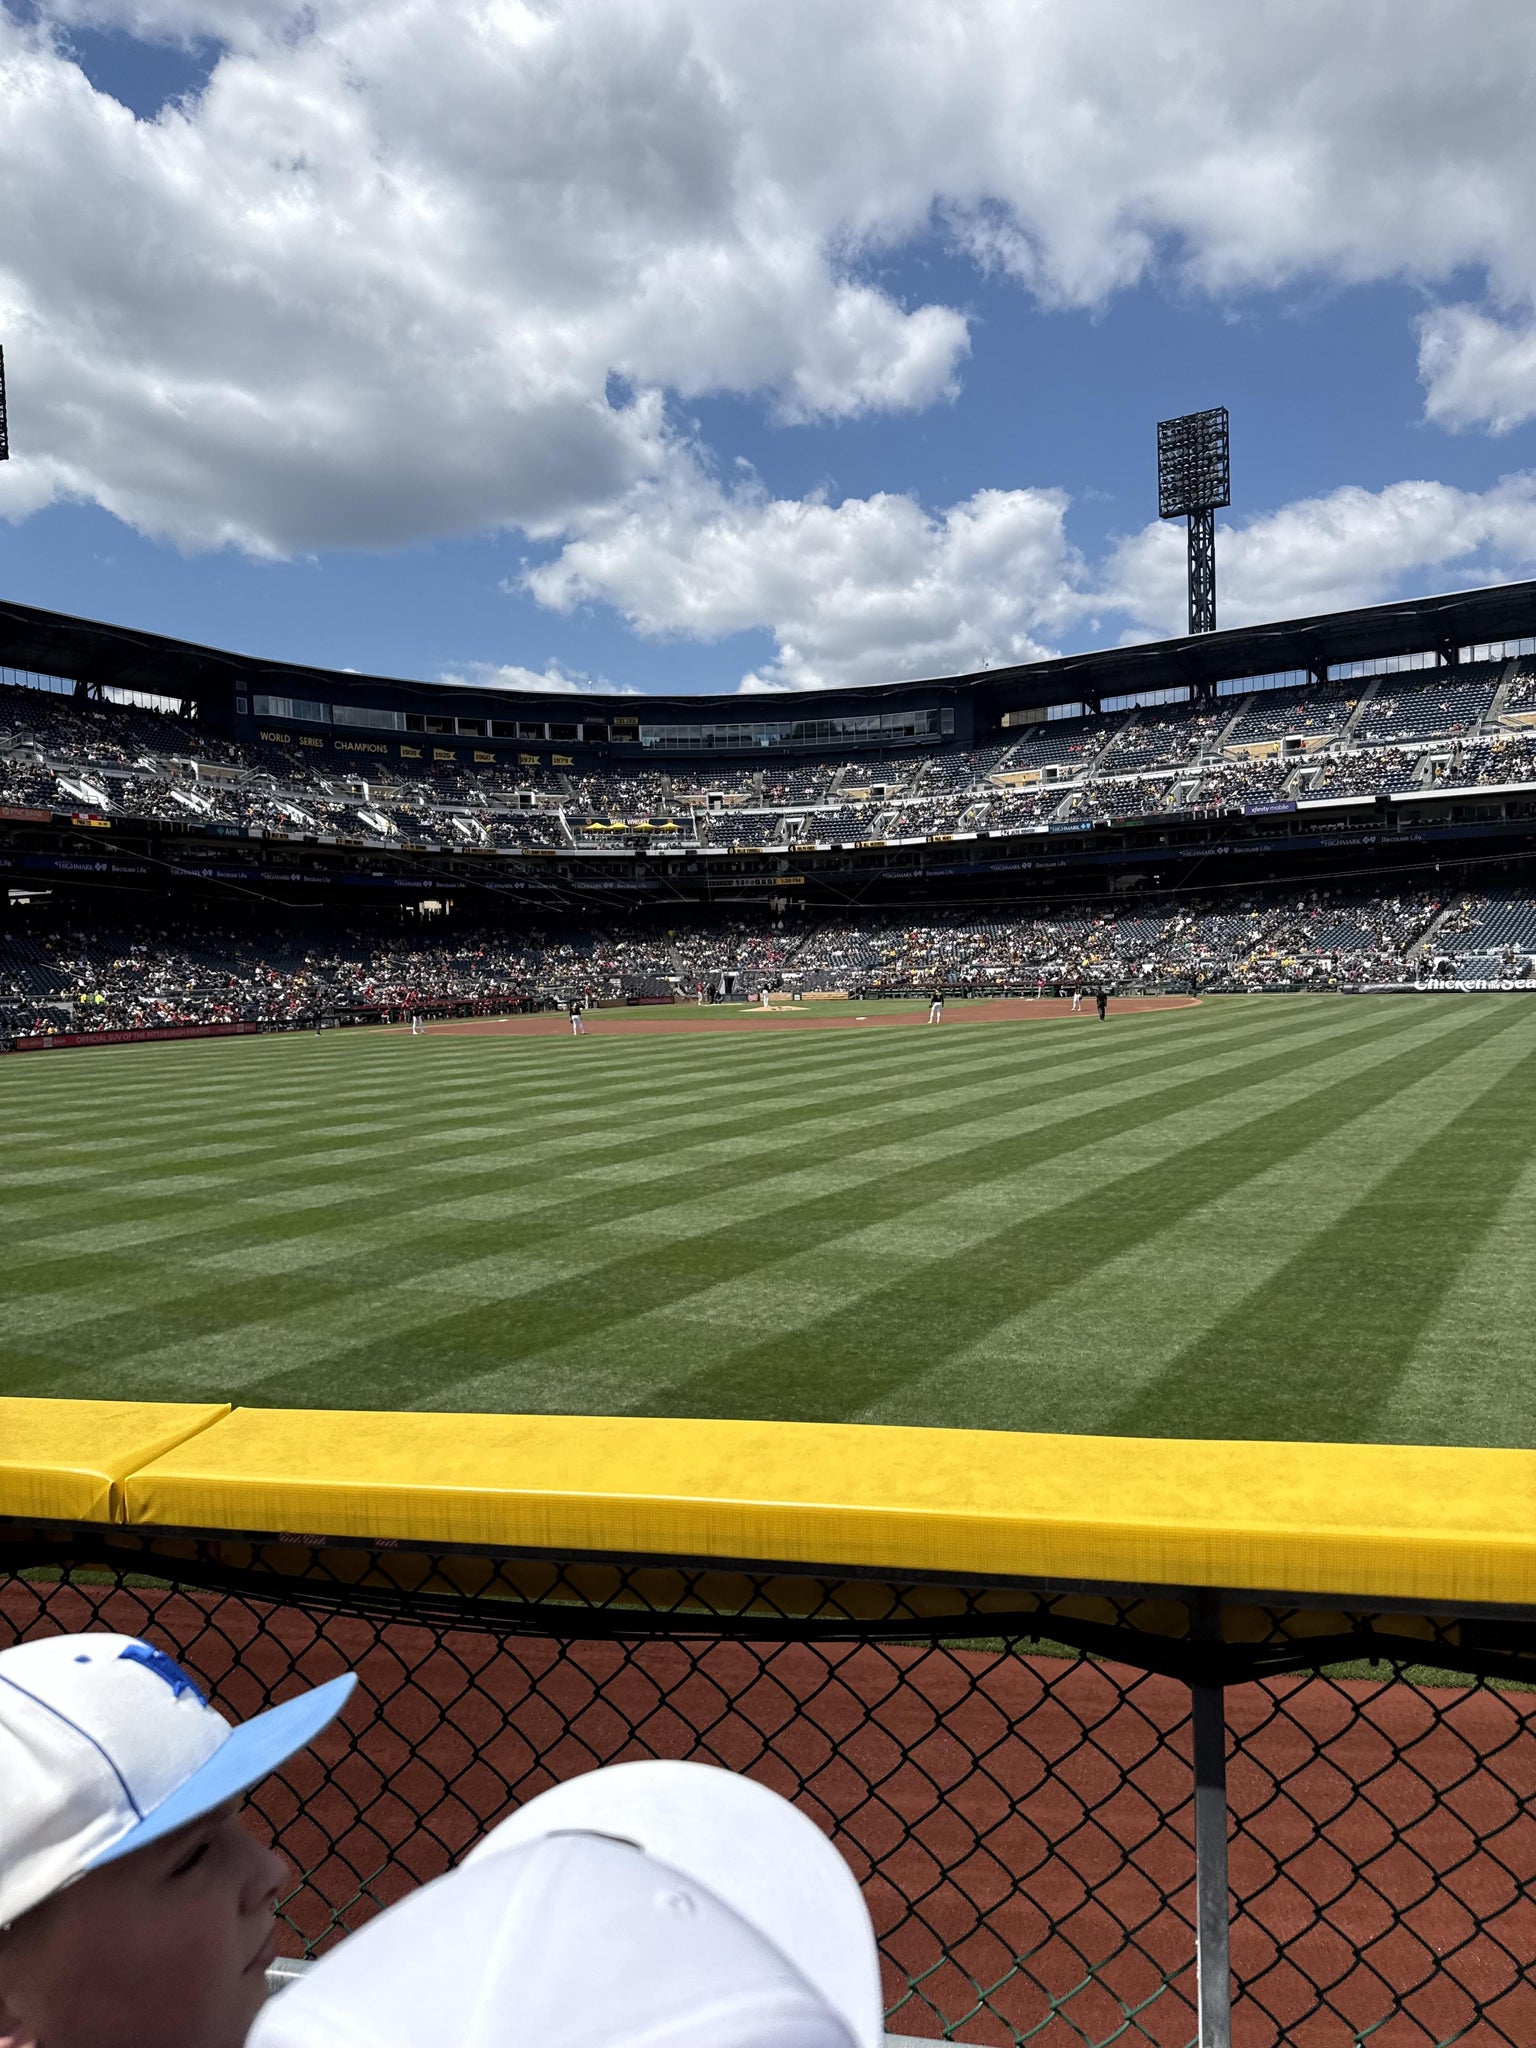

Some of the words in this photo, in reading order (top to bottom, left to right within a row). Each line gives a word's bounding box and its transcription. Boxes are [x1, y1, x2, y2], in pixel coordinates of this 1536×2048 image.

[260, 731, 291, 743] WORLD
[299, 736, 324, 748] SERIES
[334, 740, 388, 754] CHAMPIONS
[1251, 805, 1270, 813] xfinity
[225, 827, 240, 836] AHN
[1414, 979, 1487, 993] Chicken
[1500, 979, 1536, 990] Sea
[76, 1034, 107, 1044] OFFICIAL
[108, 1032, 122, 1041] SUV
[122, 1031, 132, 1040] OF
